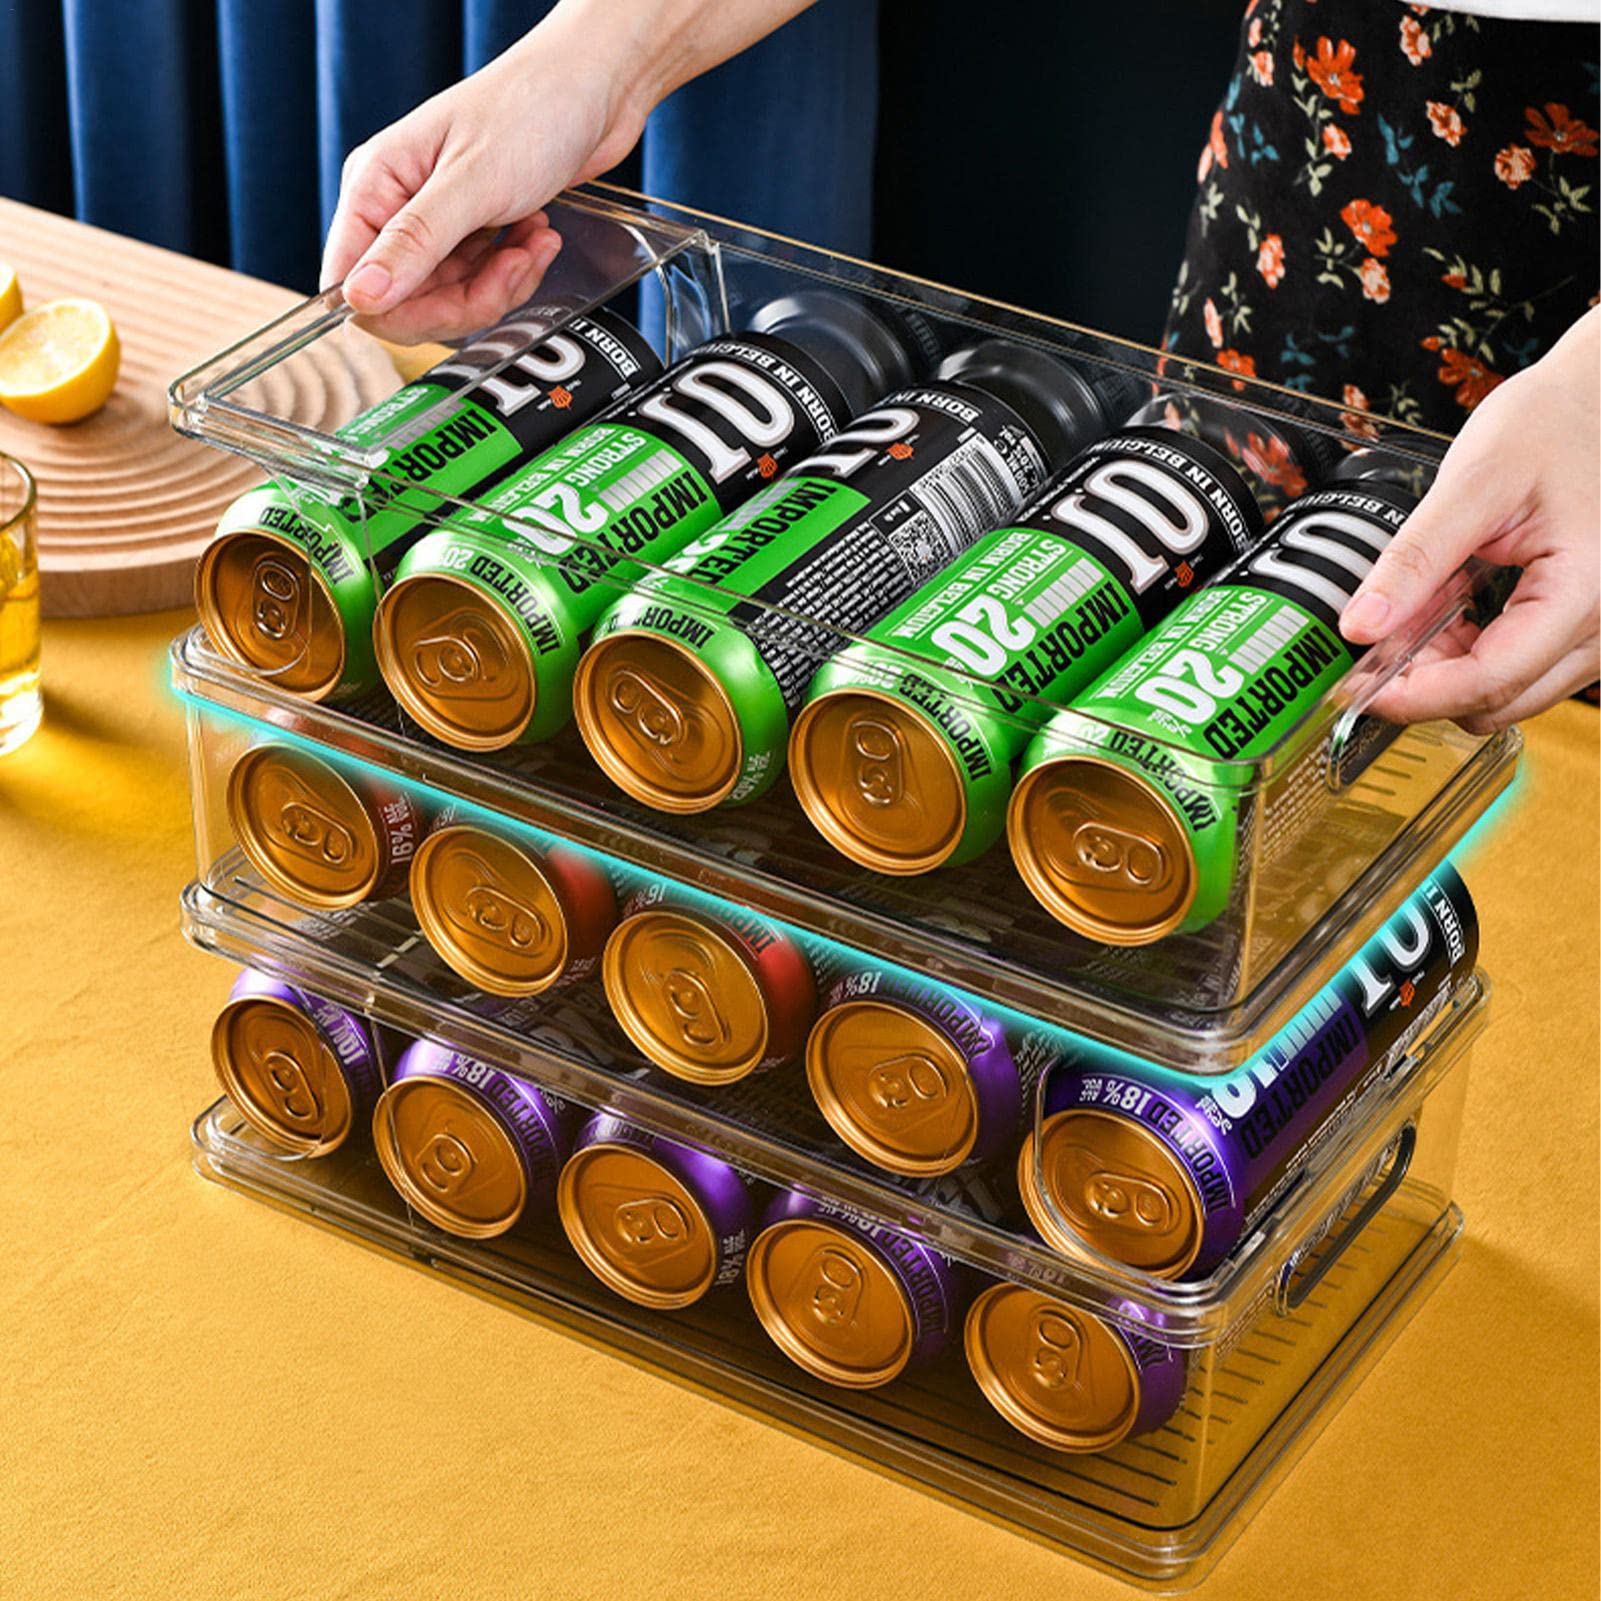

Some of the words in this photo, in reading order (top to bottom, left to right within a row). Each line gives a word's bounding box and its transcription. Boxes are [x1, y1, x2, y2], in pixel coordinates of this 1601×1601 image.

[584, 326, 640, 377] BORN
[773, 364, 799, 389] IN
[918, 394, 980, 423] BORN
[563, 432, 648, 487] STRONG
[1185, 465, 1212, 491] IN
[258, 506, 355, 585] IMPORTED
[558, 471, 708, 594] IMPORTED
[979, 532, 1033, 566] BORN
[1210, 490, 1250, 551] BORN
[960, 566, 992, 582] IN
[986, 540, 1067, 600] STRONG
[470, 554, 561, 654] IMPORTED
[891, 583, 974, 638] BELGIUM
[1188, 592, 1267, 652] STRONG
[931, 593, 1037, 677] 20
[992, 581, 1131, 714] IMPORTED
[1203, 625, 1342, 760] IMPORTED
[898, 673, 993, 782] IMPORTED
[1109, 731, 1218, 832] IMPORTED
[845, 971, 882, 999] 18%
[451, 1053, 496, 1090] 18%
[1102, 1080, 1152, 1116] 18%
[1239, 1012, 1361, 1159] IMPORTED
[1147, 1101, 1230, 1213] IMPORTED
